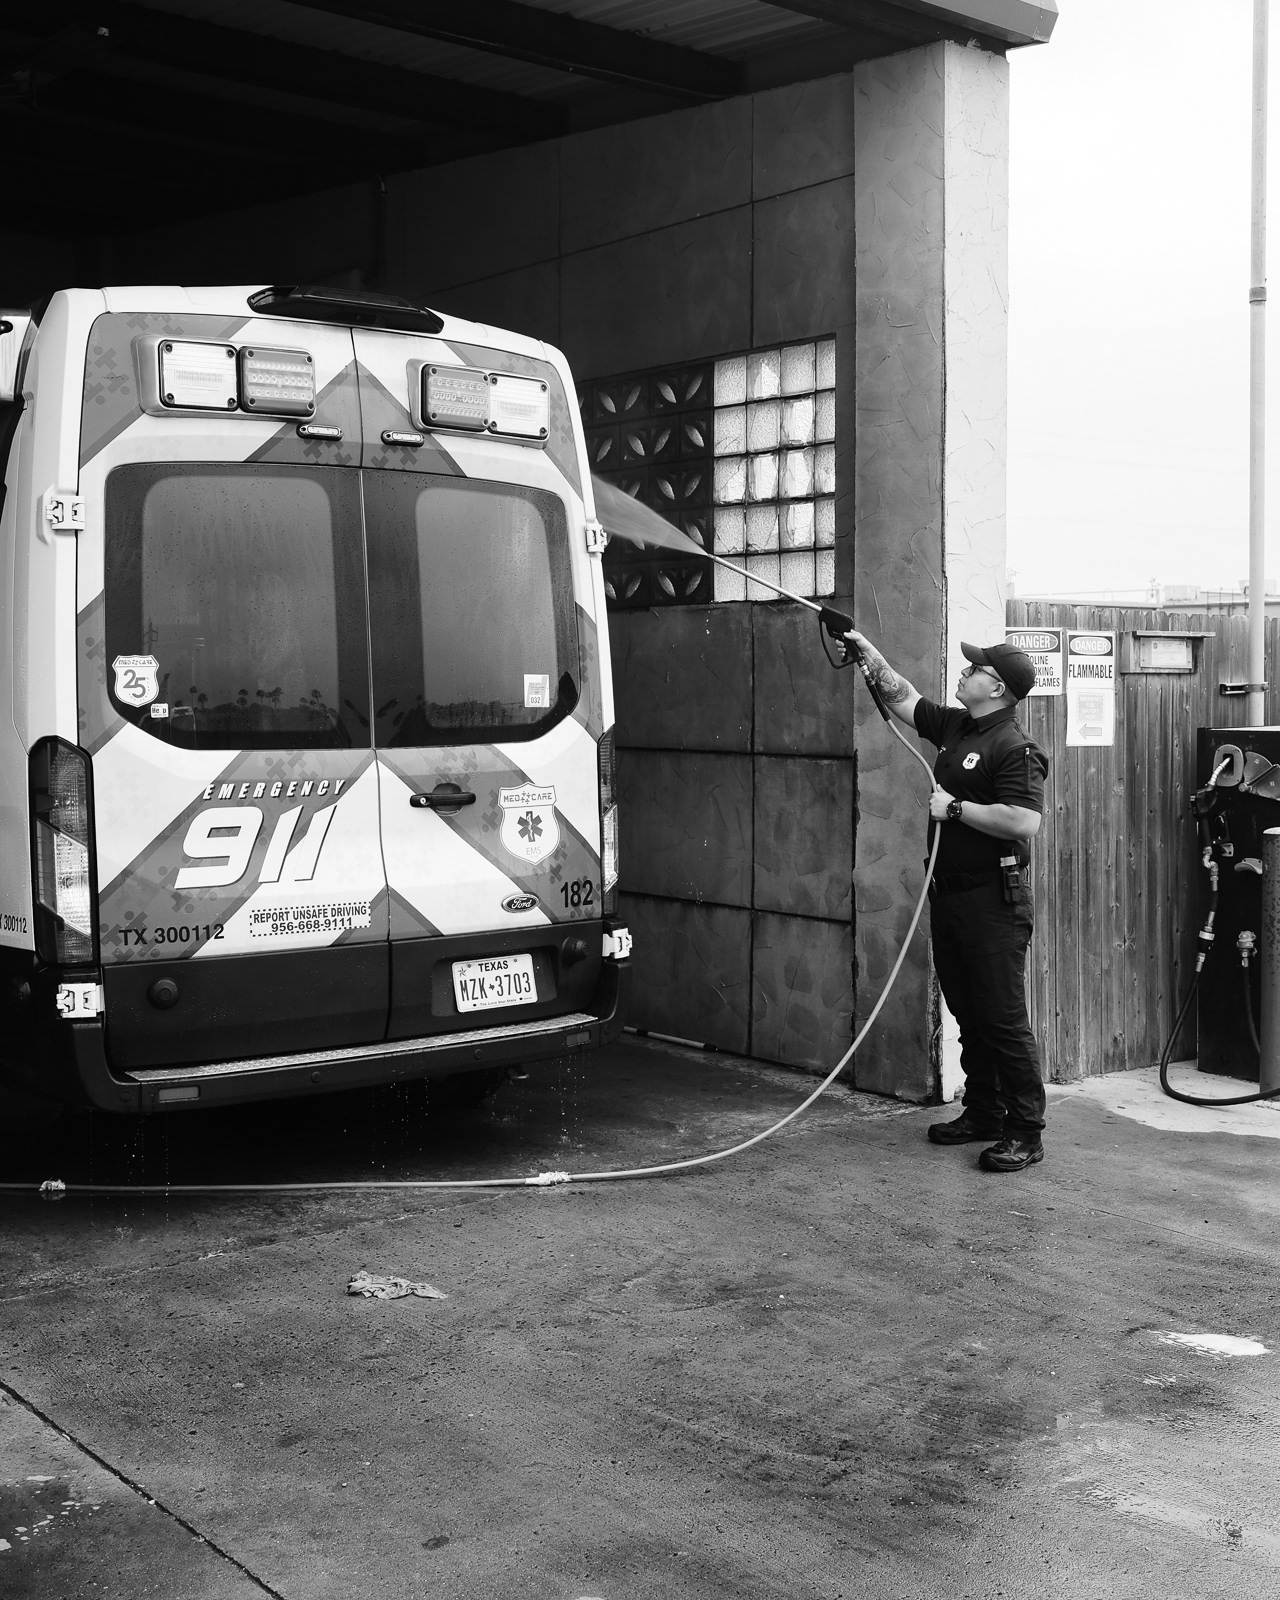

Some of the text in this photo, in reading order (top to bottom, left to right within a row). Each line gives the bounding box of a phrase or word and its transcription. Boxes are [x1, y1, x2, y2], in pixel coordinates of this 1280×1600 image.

[1012, 635, 1051, 649] DANGER
[1075, 640, 1108, 651] DANGER
[1030, 655, 1049, 665] OLINE
[1034, 666, 1054, 677] OKING
[1068, 664, 1113, 679] FLAMMABLE
[123, 669, 146, 698] 25
[203, 779, 345, 800] EMERGENCY
[174, 804, 337, 890] 911
[526, 846, 542, 856] EMS
[560, 879, 594, 908] 182
[511, 896, 532, 909] Ford
[253, 905, 367, 924] REPORT UNSAFE DRIVING
[3, 914, 28, 934] 300112
[271, 917, 352, 933] 956-668-9111
[118, 923, 225, 946] TX 300112
[478, 960, 509, 972] TEXAS
